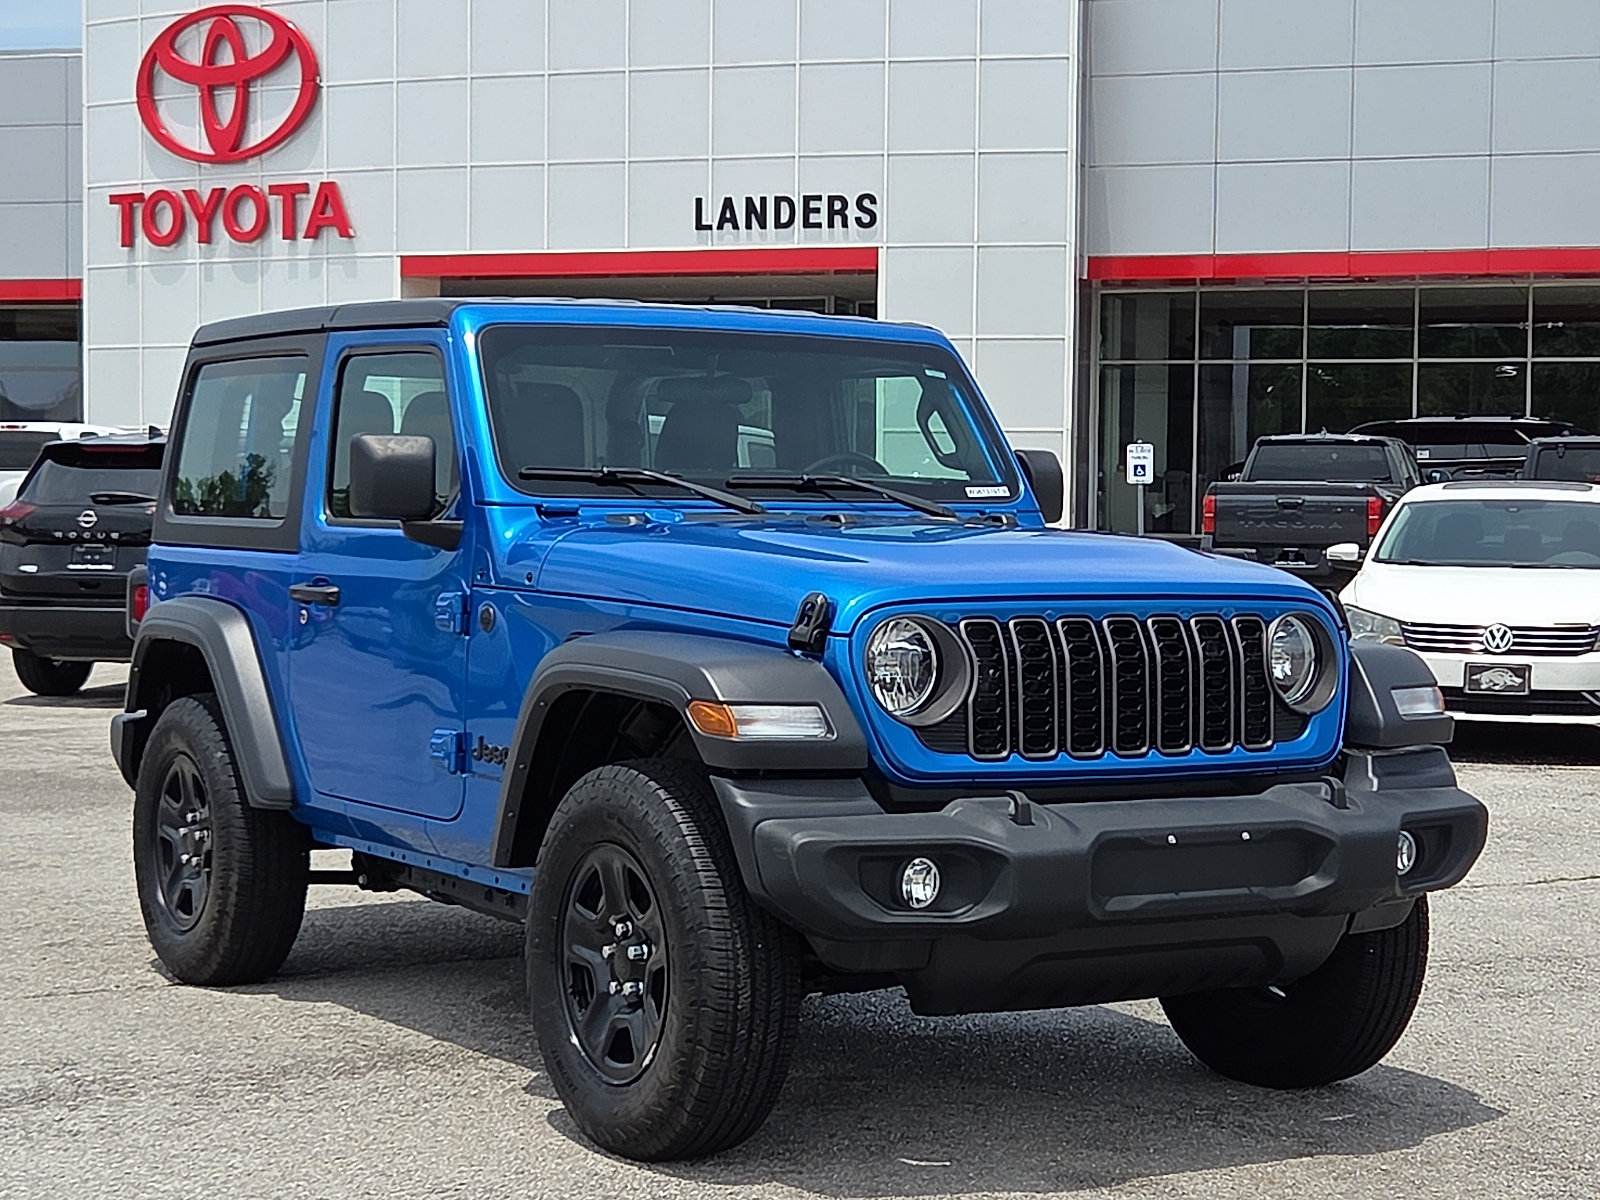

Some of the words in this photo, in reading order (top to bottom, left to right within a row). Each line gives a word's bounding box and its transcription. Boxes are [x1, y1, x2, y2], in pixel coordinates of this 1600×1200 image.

[109, 182, 355, 248] TOYOTA
[695, 193, 877, 231] LANDERS
[53, 531, 119, 539] ROGUE
[1238, 520, 1343, 529] TACOMA
[472, 735, 510, 771] Jeep
